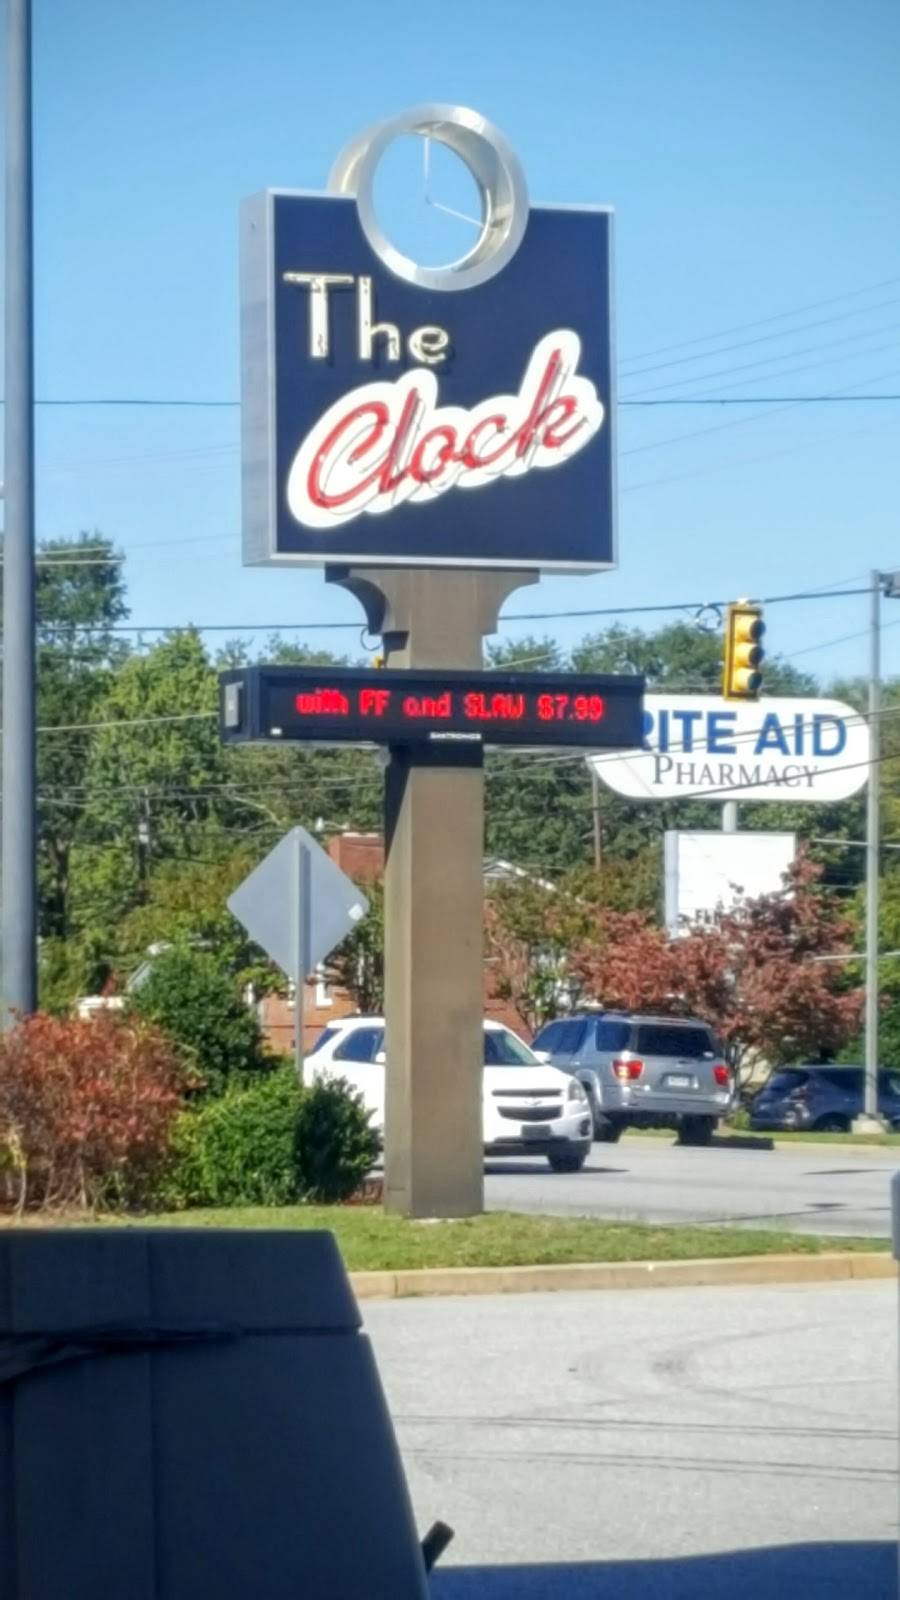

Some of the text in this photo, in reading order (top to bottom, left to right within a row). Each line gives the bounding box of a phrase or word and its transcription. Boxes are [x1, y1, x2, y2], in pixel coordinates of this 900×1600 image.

[283, 271, 450, 364] The
[303, 345, 592, 512] Clock
[295, 687, 348, 716] with
[358, 689, 391, 716] FF
[402, 692, 451, 719] and
[463, 692, 525, 720] SLAW
[753, 712, 848, 757] AID
